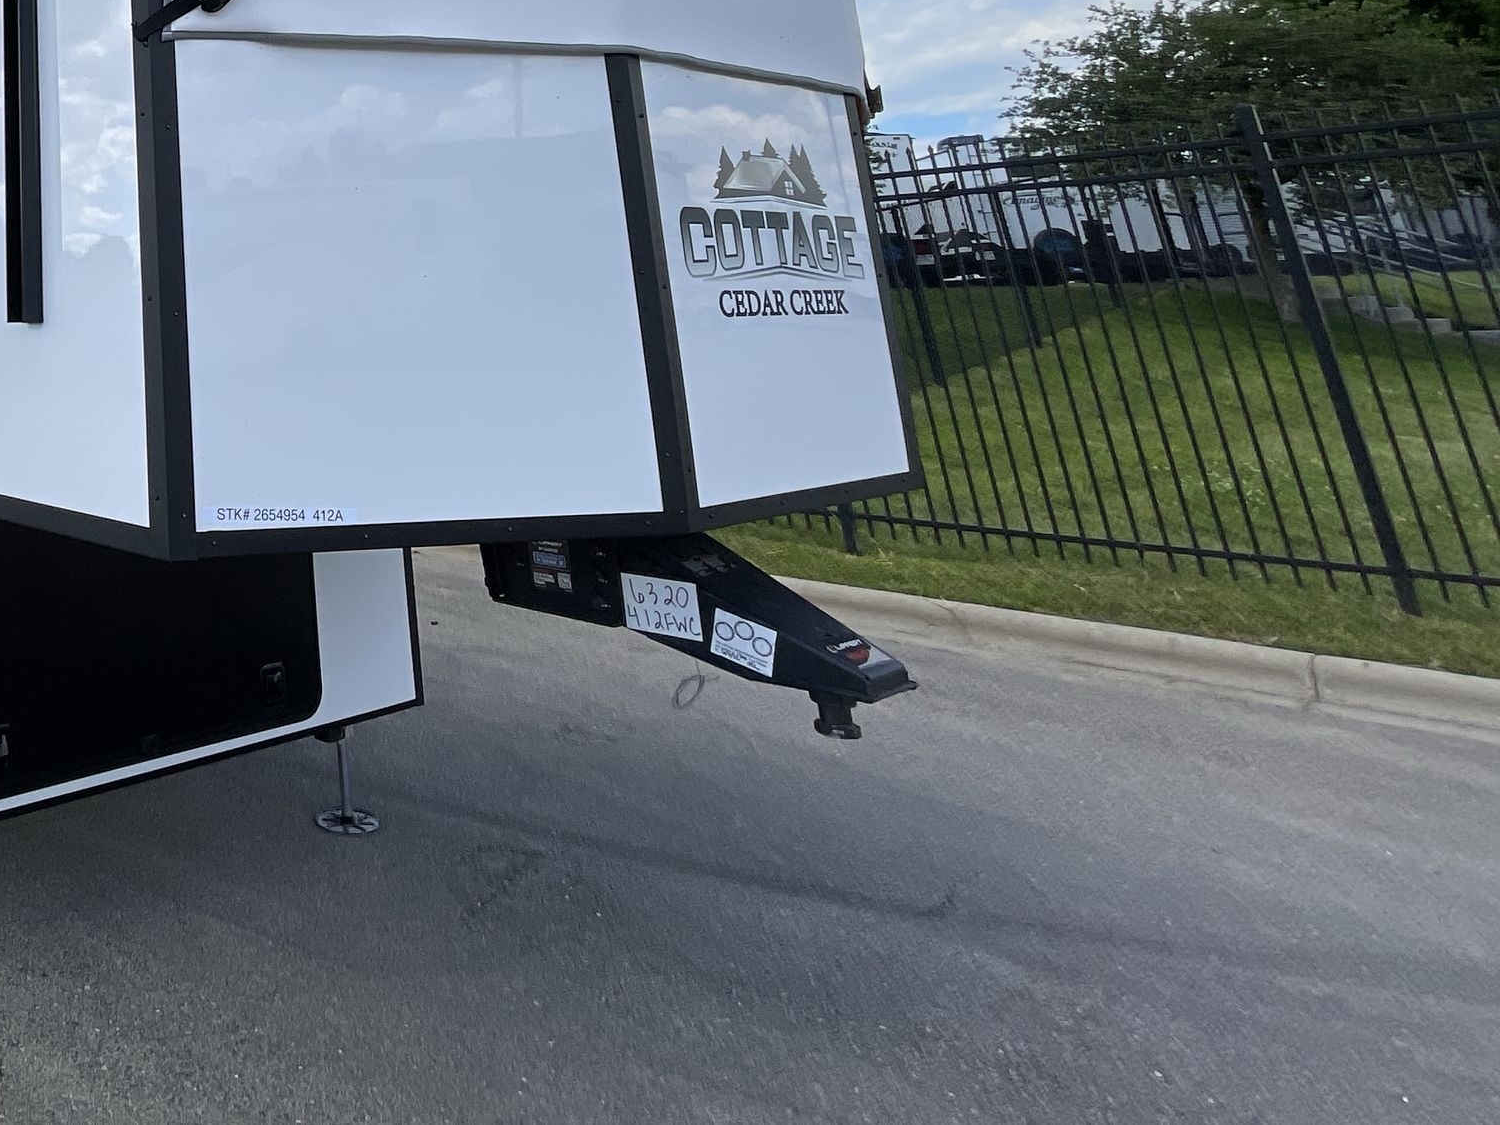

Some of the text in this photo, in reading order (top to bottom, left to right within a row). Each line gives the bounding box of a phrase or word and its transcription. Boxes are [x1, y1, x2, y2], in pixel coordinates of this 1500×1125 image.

[679, 206, 866, 280] COTTAGE
[719, 289, 850, 318] CEDAR CREEK
[216, 507, 344, 522] STK# 2654954 412A
[629, 578, 689, 609] 6320
[626, 604, 702, 636] 412FWC
